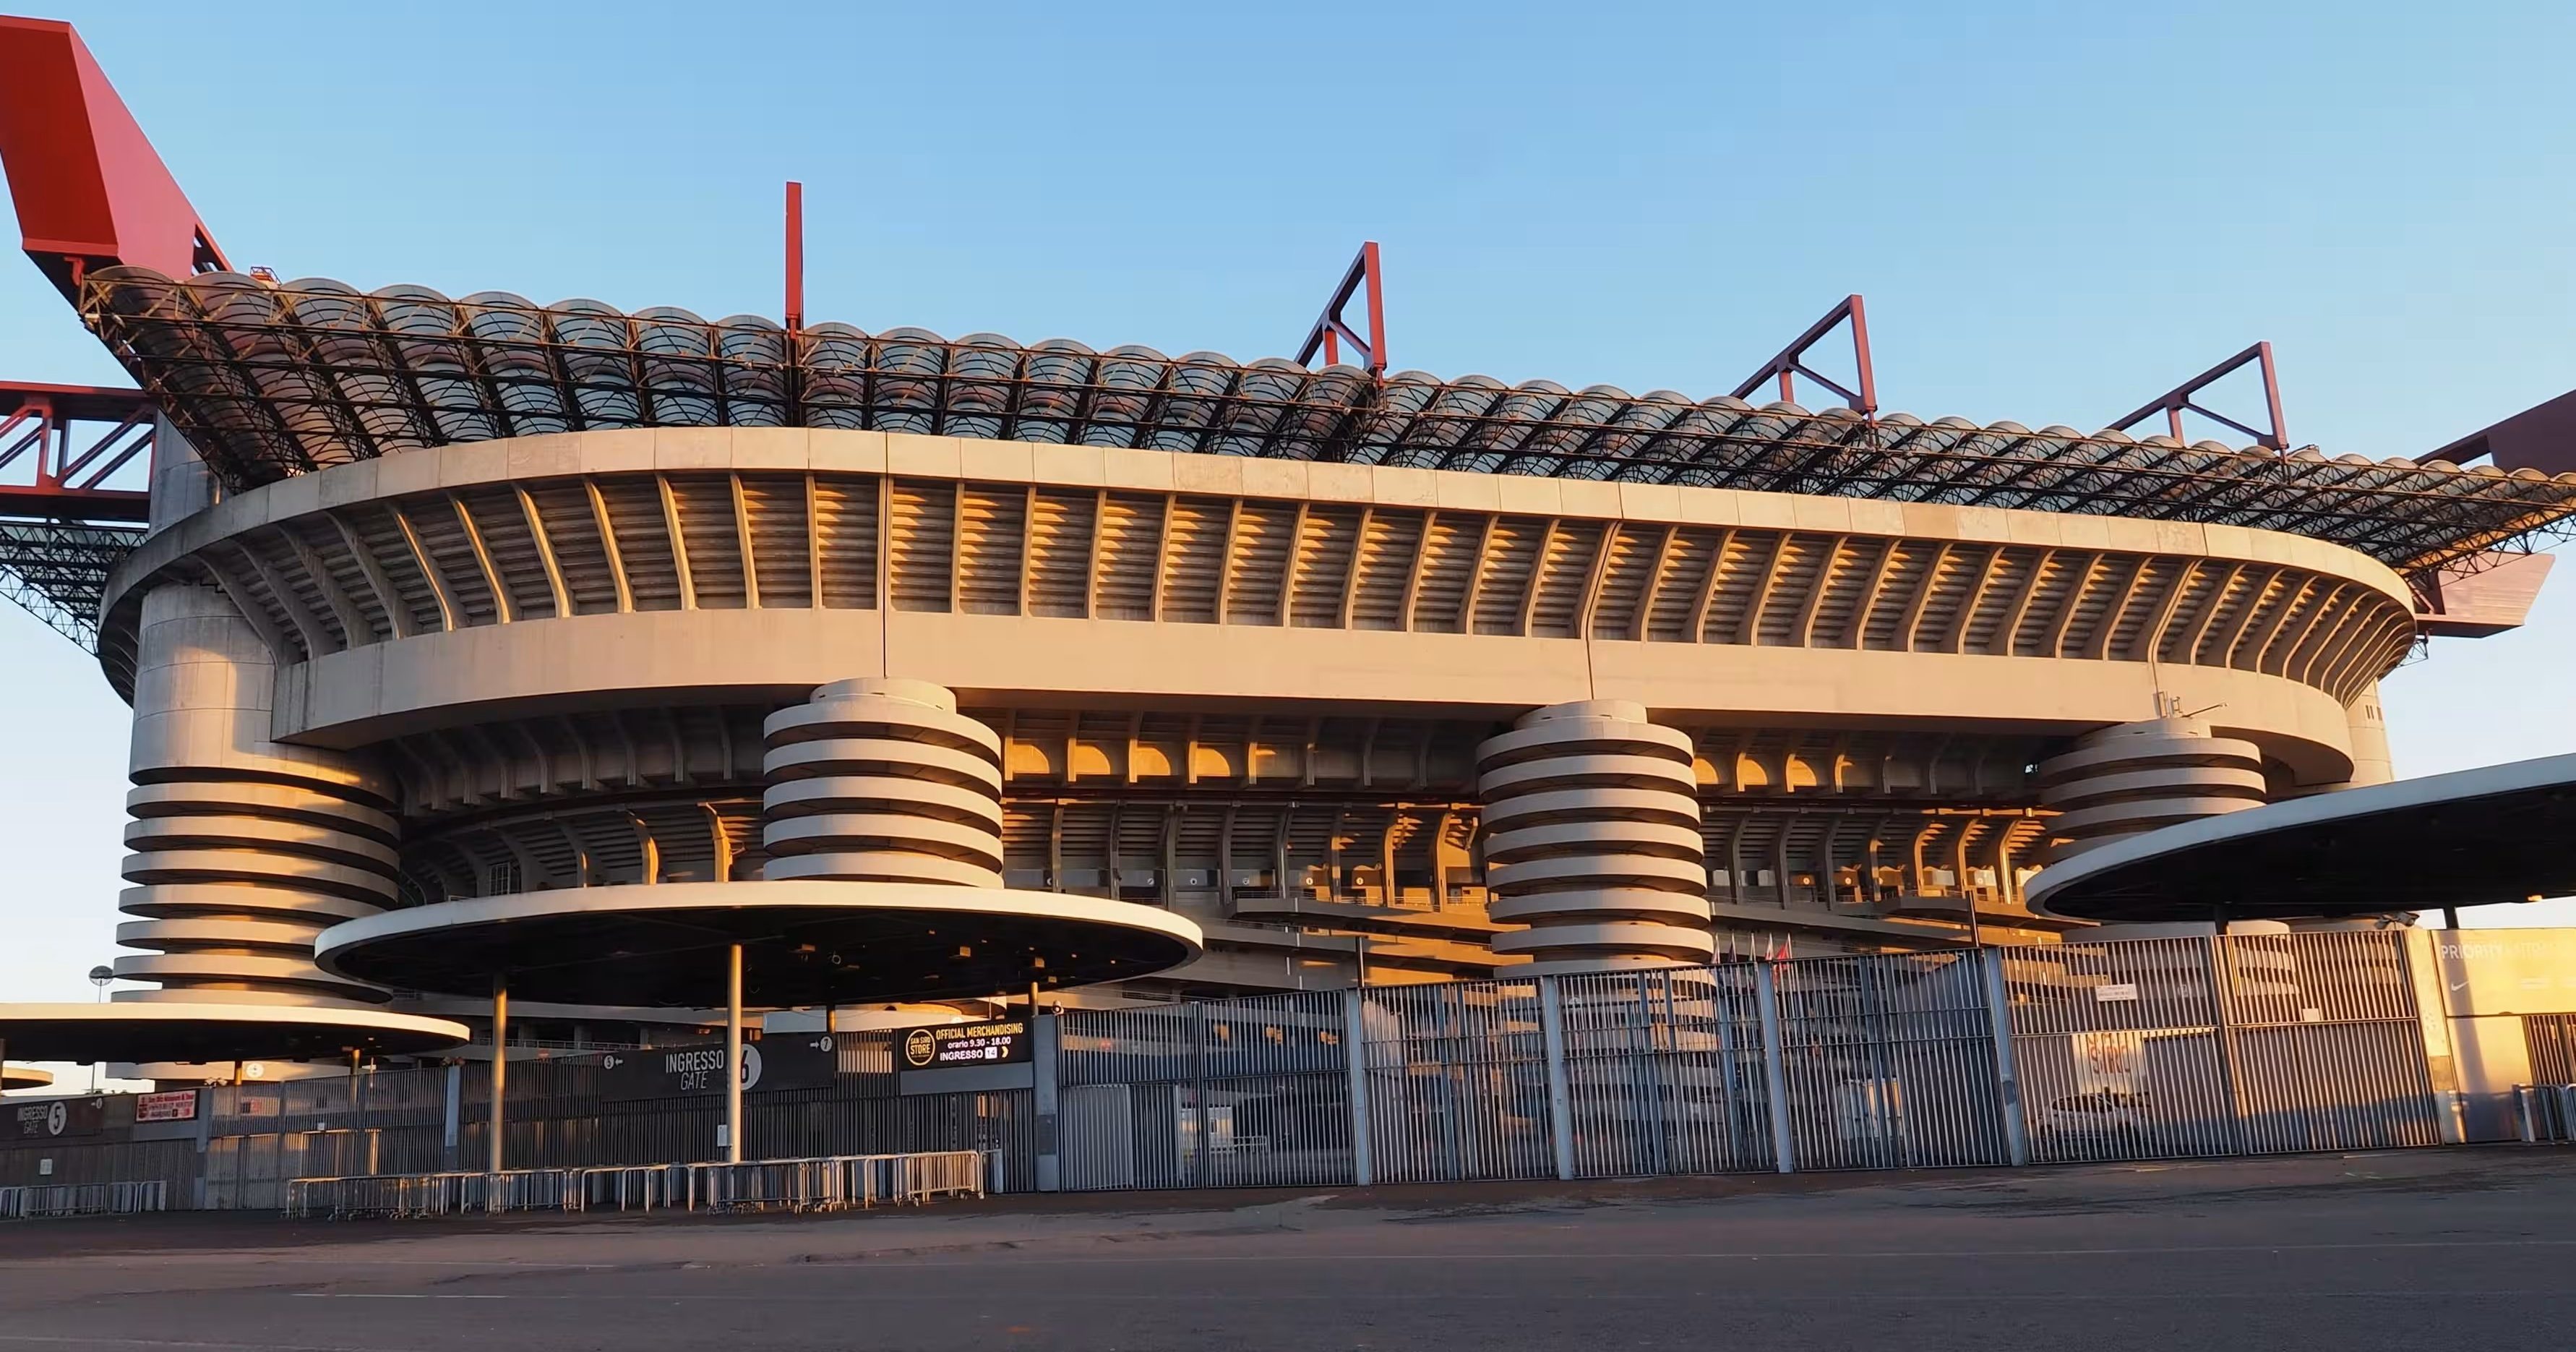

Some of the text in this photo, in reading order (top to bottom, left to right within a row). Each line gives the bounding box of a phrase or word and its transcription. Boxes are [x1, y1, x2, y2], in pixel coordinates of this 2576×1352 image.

[935, 1022, 1023, 1041] OFFICIAL MERCHANDISING
[910, 1044, 931, 1055] STORE
[948, 1040, 969, 1049] orario
[969, 1038, 985, 1048] 9.30
[991, 1036, 1011, 1046] 18.00
[940, 1049, 984, 1061] INGRESSO
[666, 1049, 750, 1084] INGRESSO 6
[681, 1071, 708, 1090] GATE
[52, 1105, 62, 1131] 5
